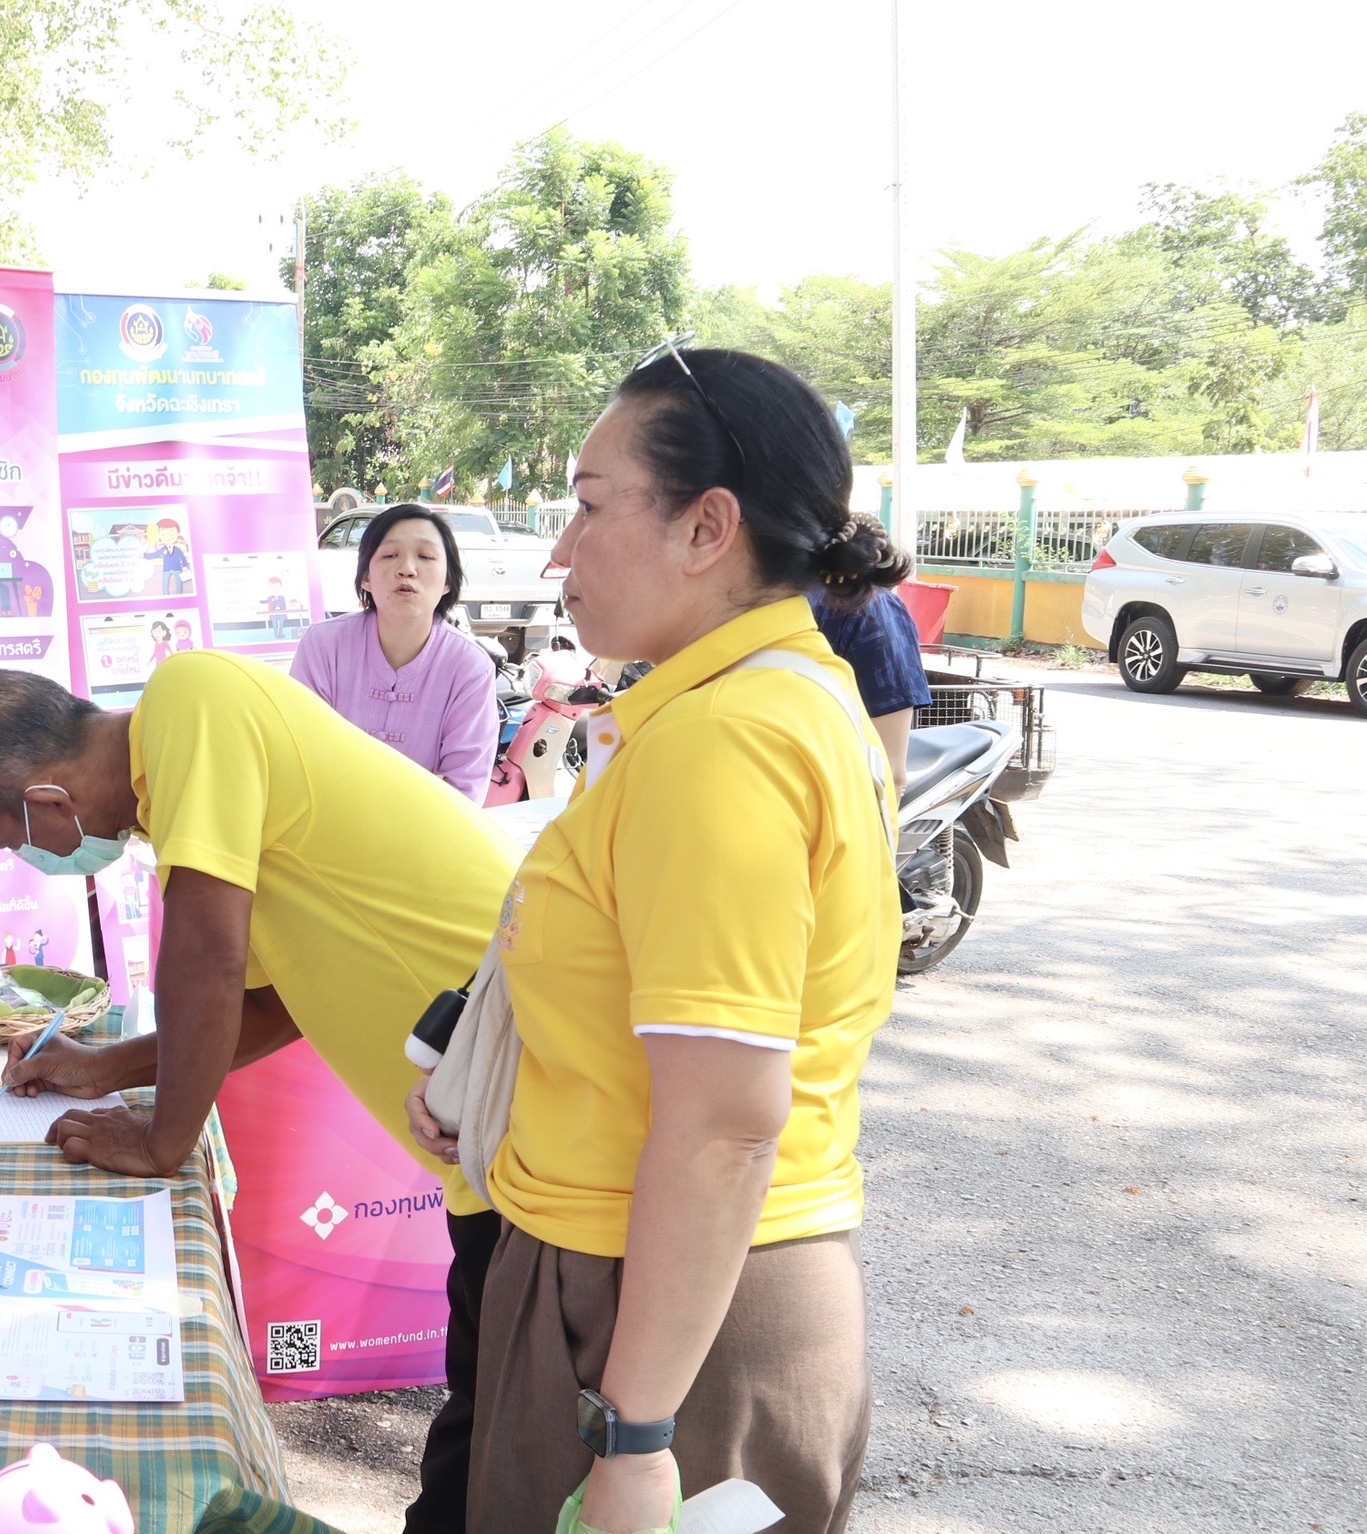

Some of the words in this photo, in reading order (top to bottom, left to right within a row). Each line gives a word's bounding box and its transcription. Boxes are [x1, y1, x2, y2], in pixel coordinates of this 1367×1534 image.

[116, 393, 242, 414] จังหวัดฉะเชิงเทรา
[107, 466, 261, 490] มีข่าวดีมาอกจ้า!!
